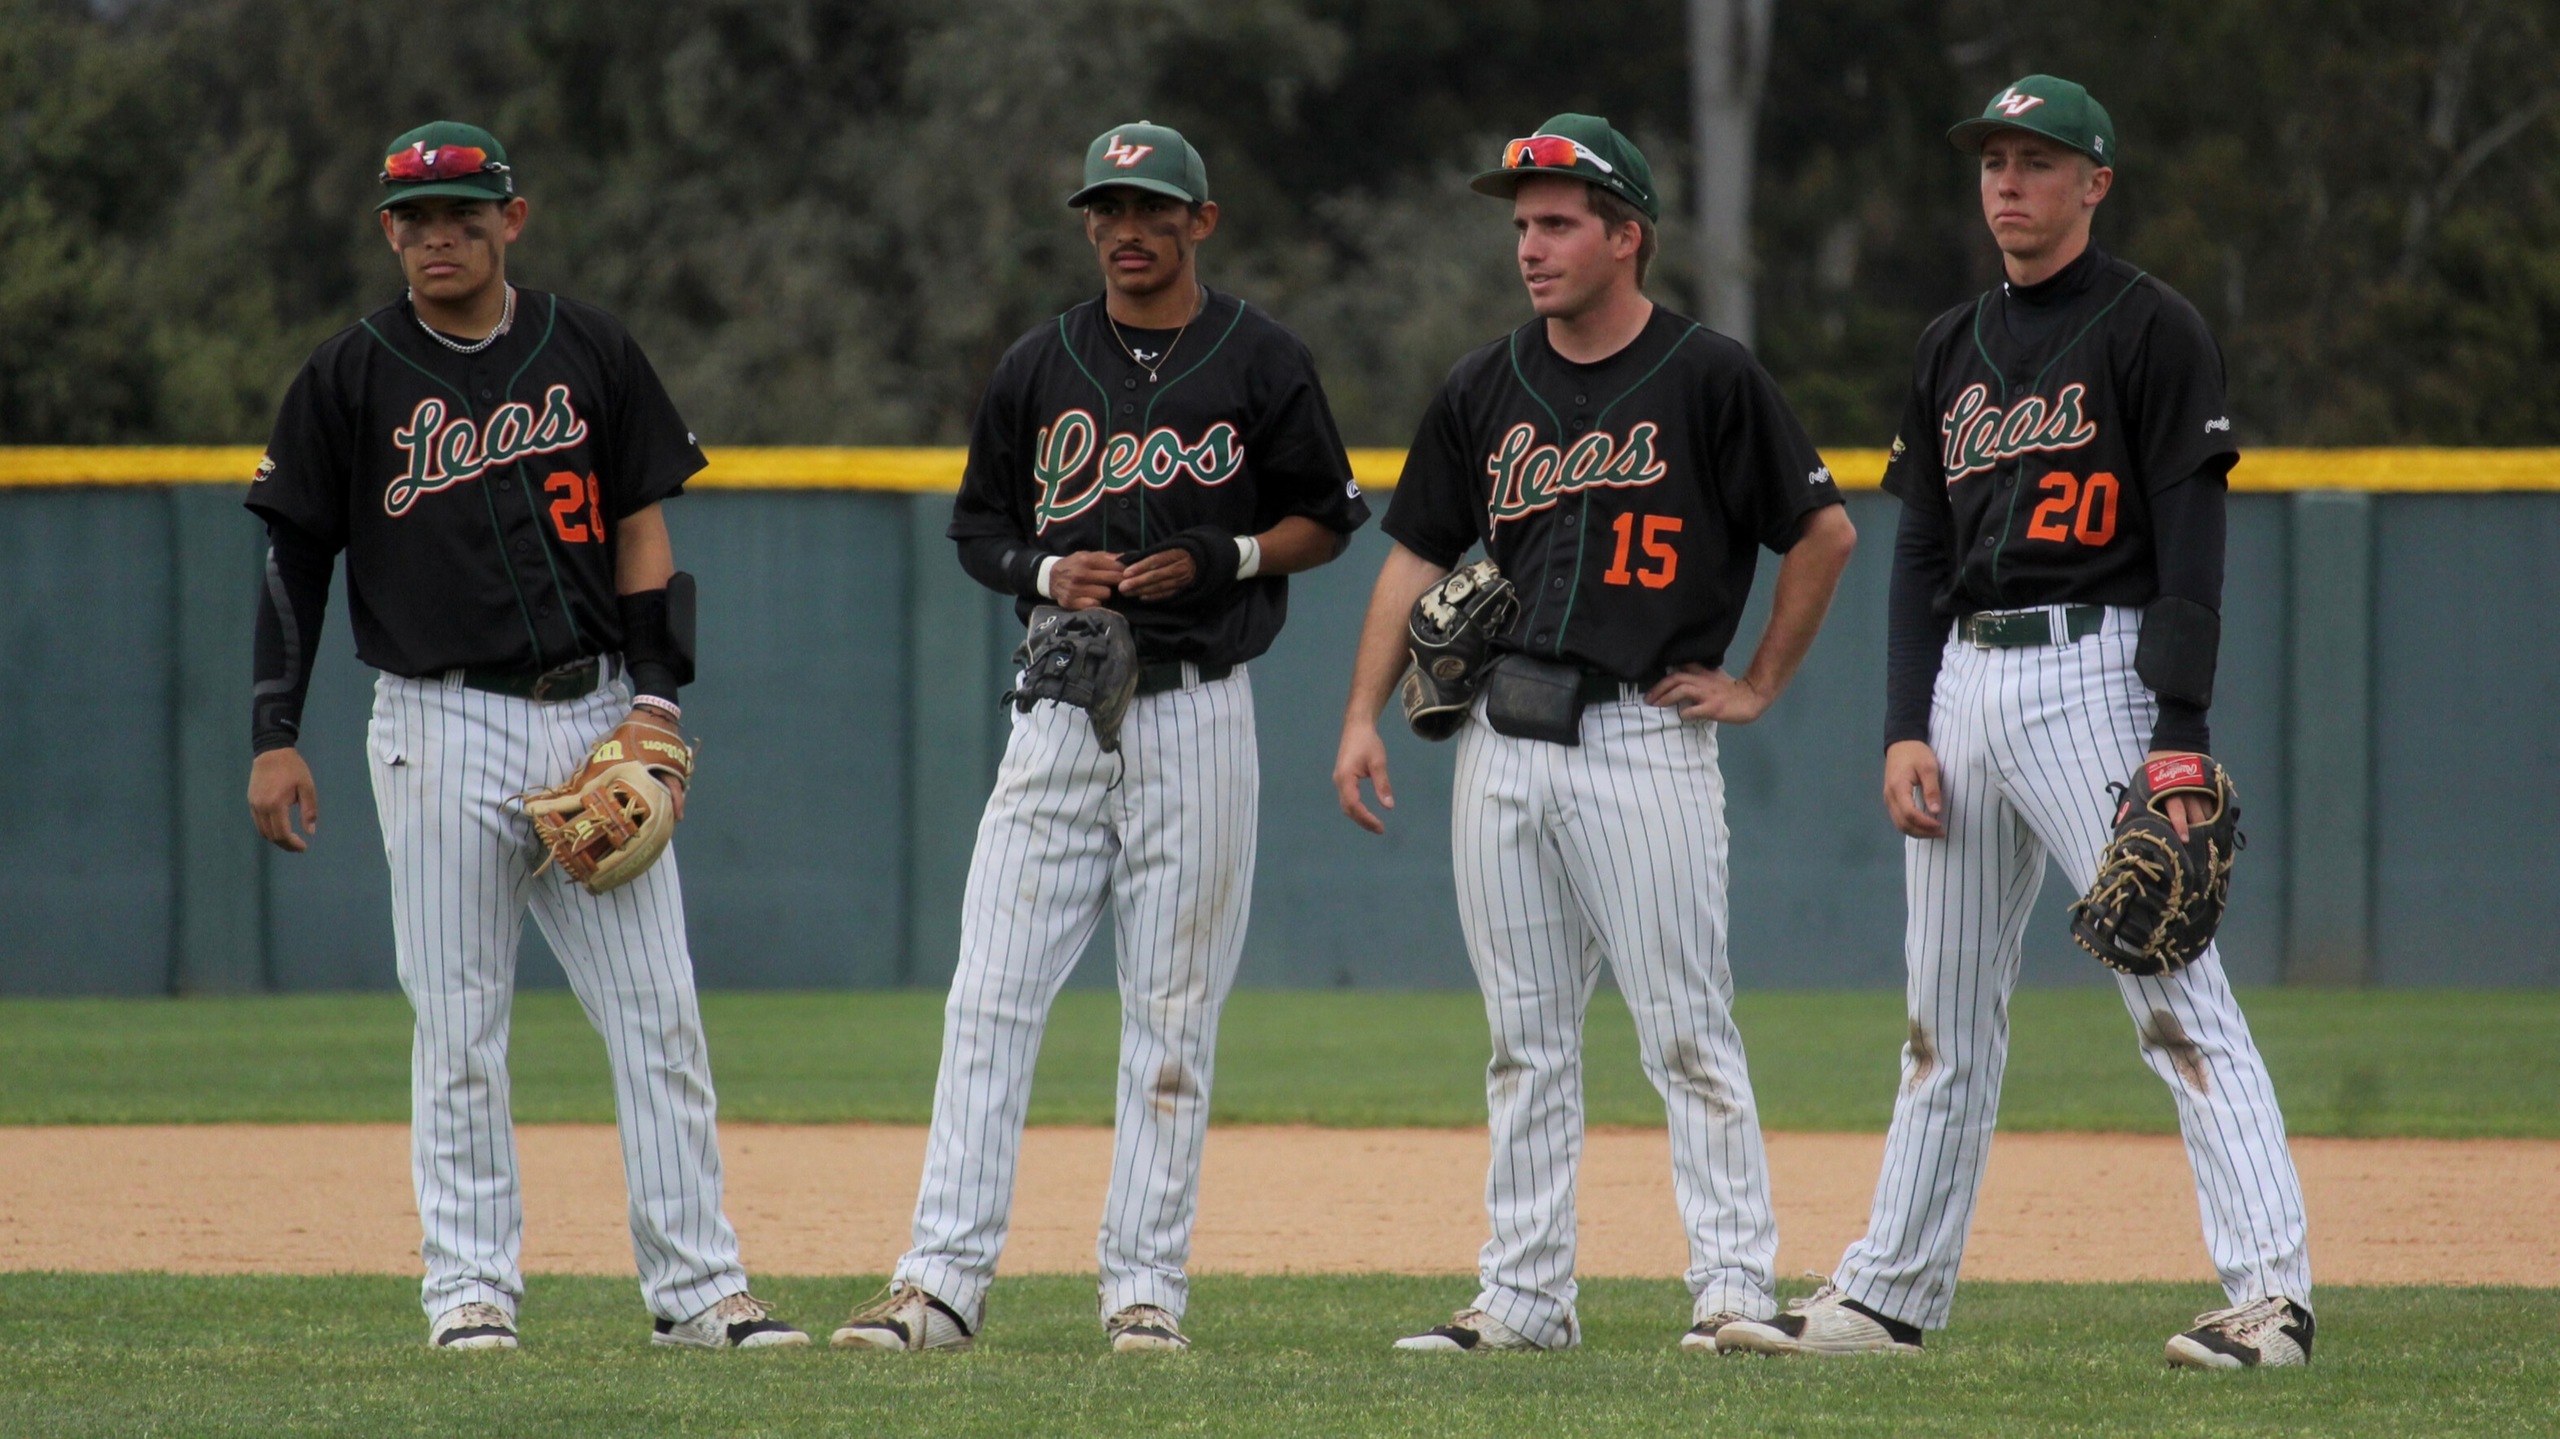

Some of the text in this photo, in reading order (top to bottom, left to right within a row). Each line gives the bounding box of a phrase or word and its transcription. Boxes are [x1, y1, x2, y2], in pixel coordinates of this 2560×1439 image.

[1103, 134, 1153, 168] LV
[1995, 86, 2045, 118] LV
[384, 384, 587, 516] Leos
[1034, 408, 1244, 536] Leos
[1487, 421, 1667, 542] Leos
[1941, 382, 2097, 503] Leos
[1604, 511, 1683, 589] 15
[2027, 471, 2119, 546] 20
